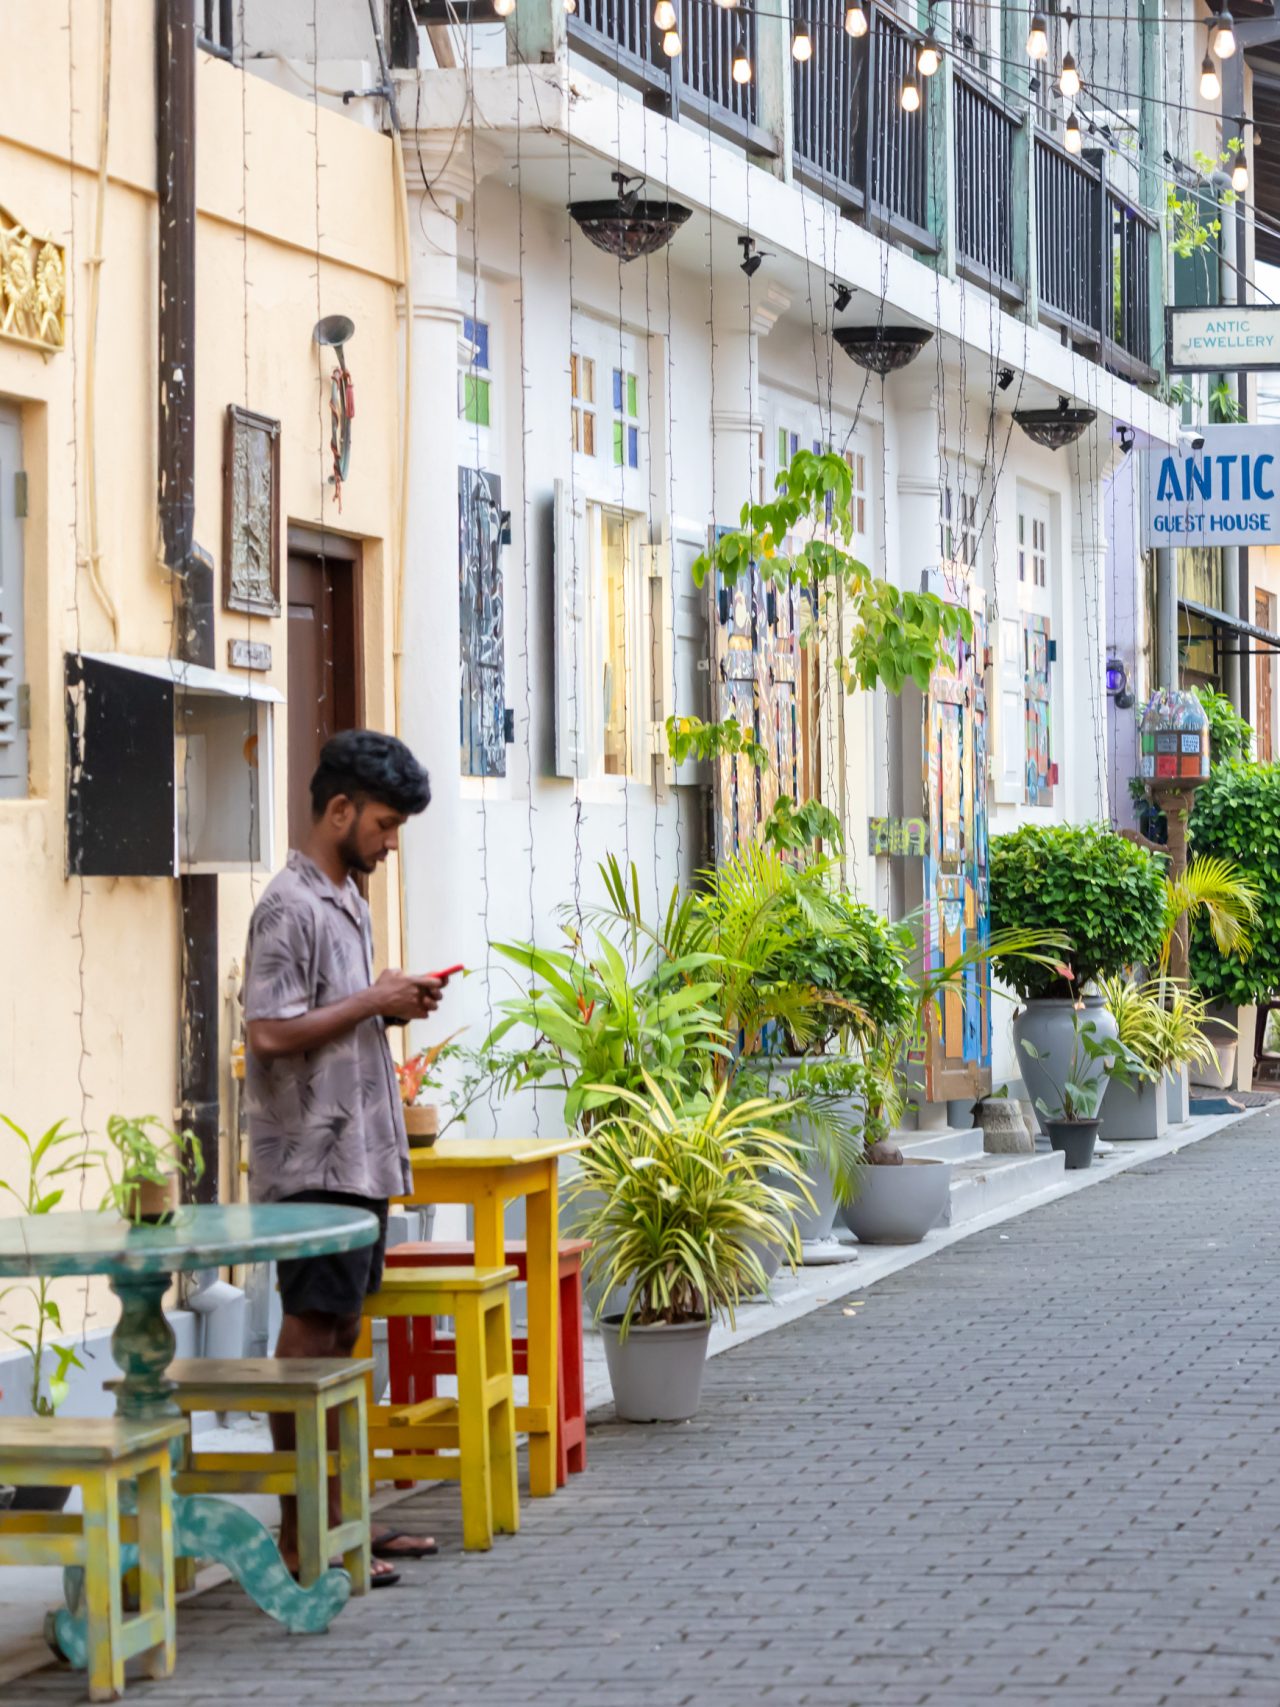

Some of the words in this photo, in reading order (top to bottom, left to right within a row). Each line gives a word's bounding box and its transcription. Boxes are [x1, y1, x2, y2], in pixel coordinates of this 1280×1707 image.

[1206, 321, 1250, 333] ANTIC
[1187, 335, 1274, 348] JEWELLERY
[1156, 454, 1275, 501] ANTIC
[1153, 515, 1205, 532] GUEST
[1210, 513, 1271, 531] HOUSE
